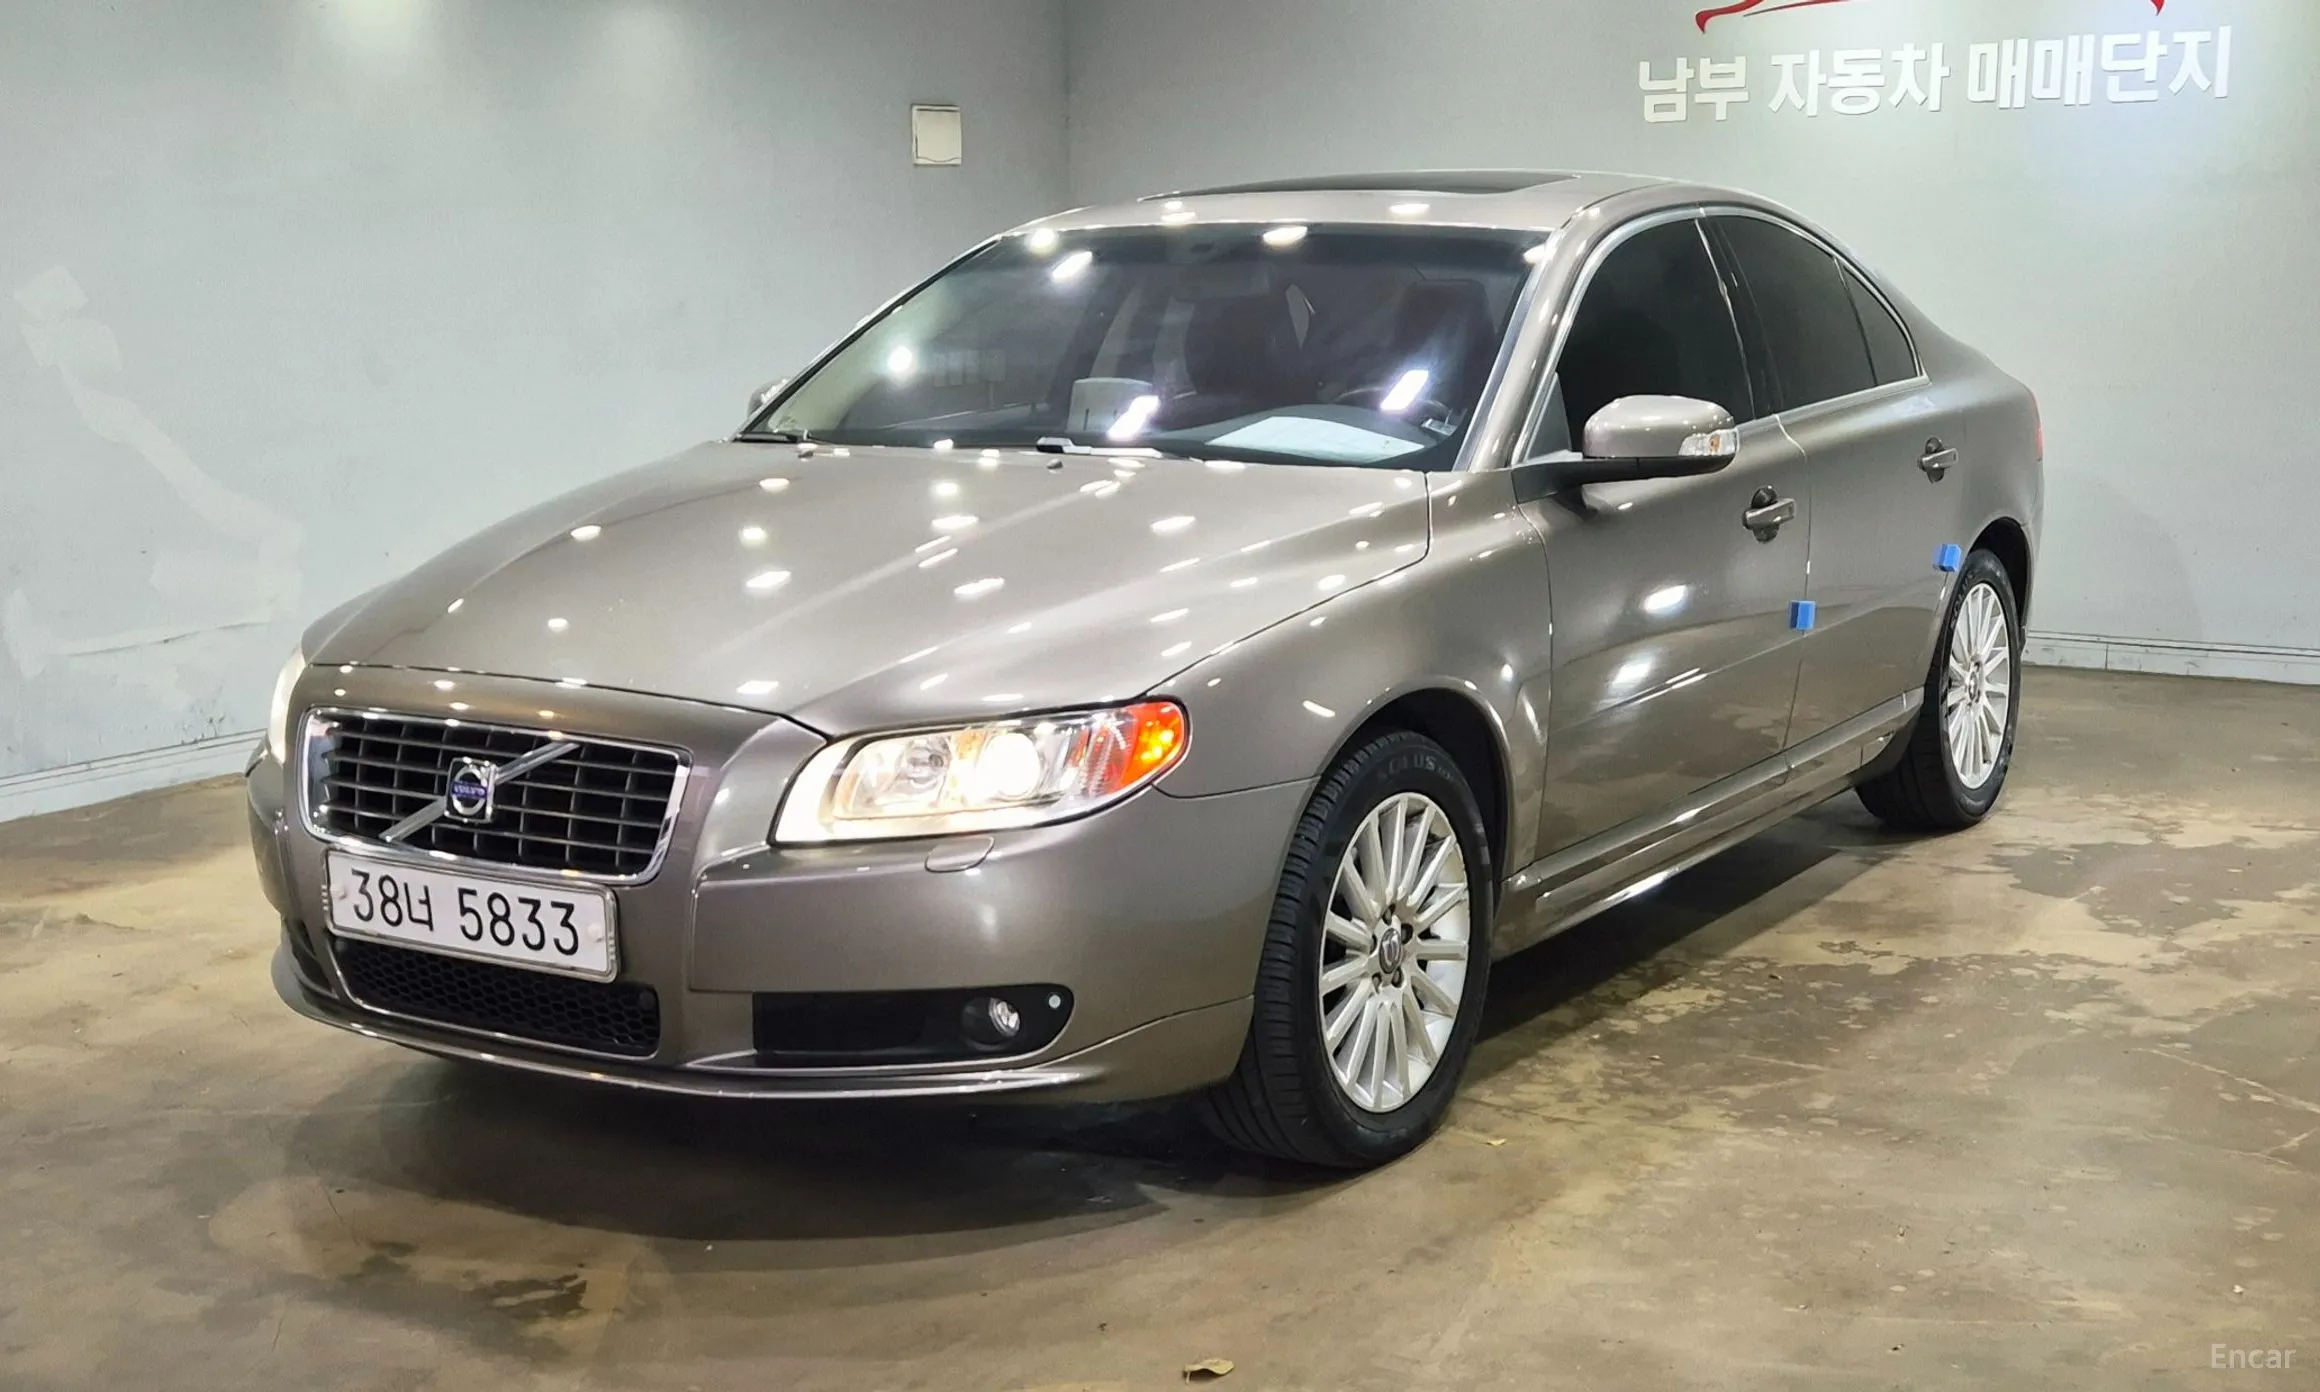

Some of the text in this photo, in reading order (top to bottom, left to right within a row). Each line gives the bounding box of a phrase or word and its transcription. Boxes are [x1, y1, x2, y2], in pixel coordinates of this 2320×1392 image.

[1639, 26, 2232, 122] 남부 자동차 매매단지
[351, 869, 580, 956] 38너 5833
